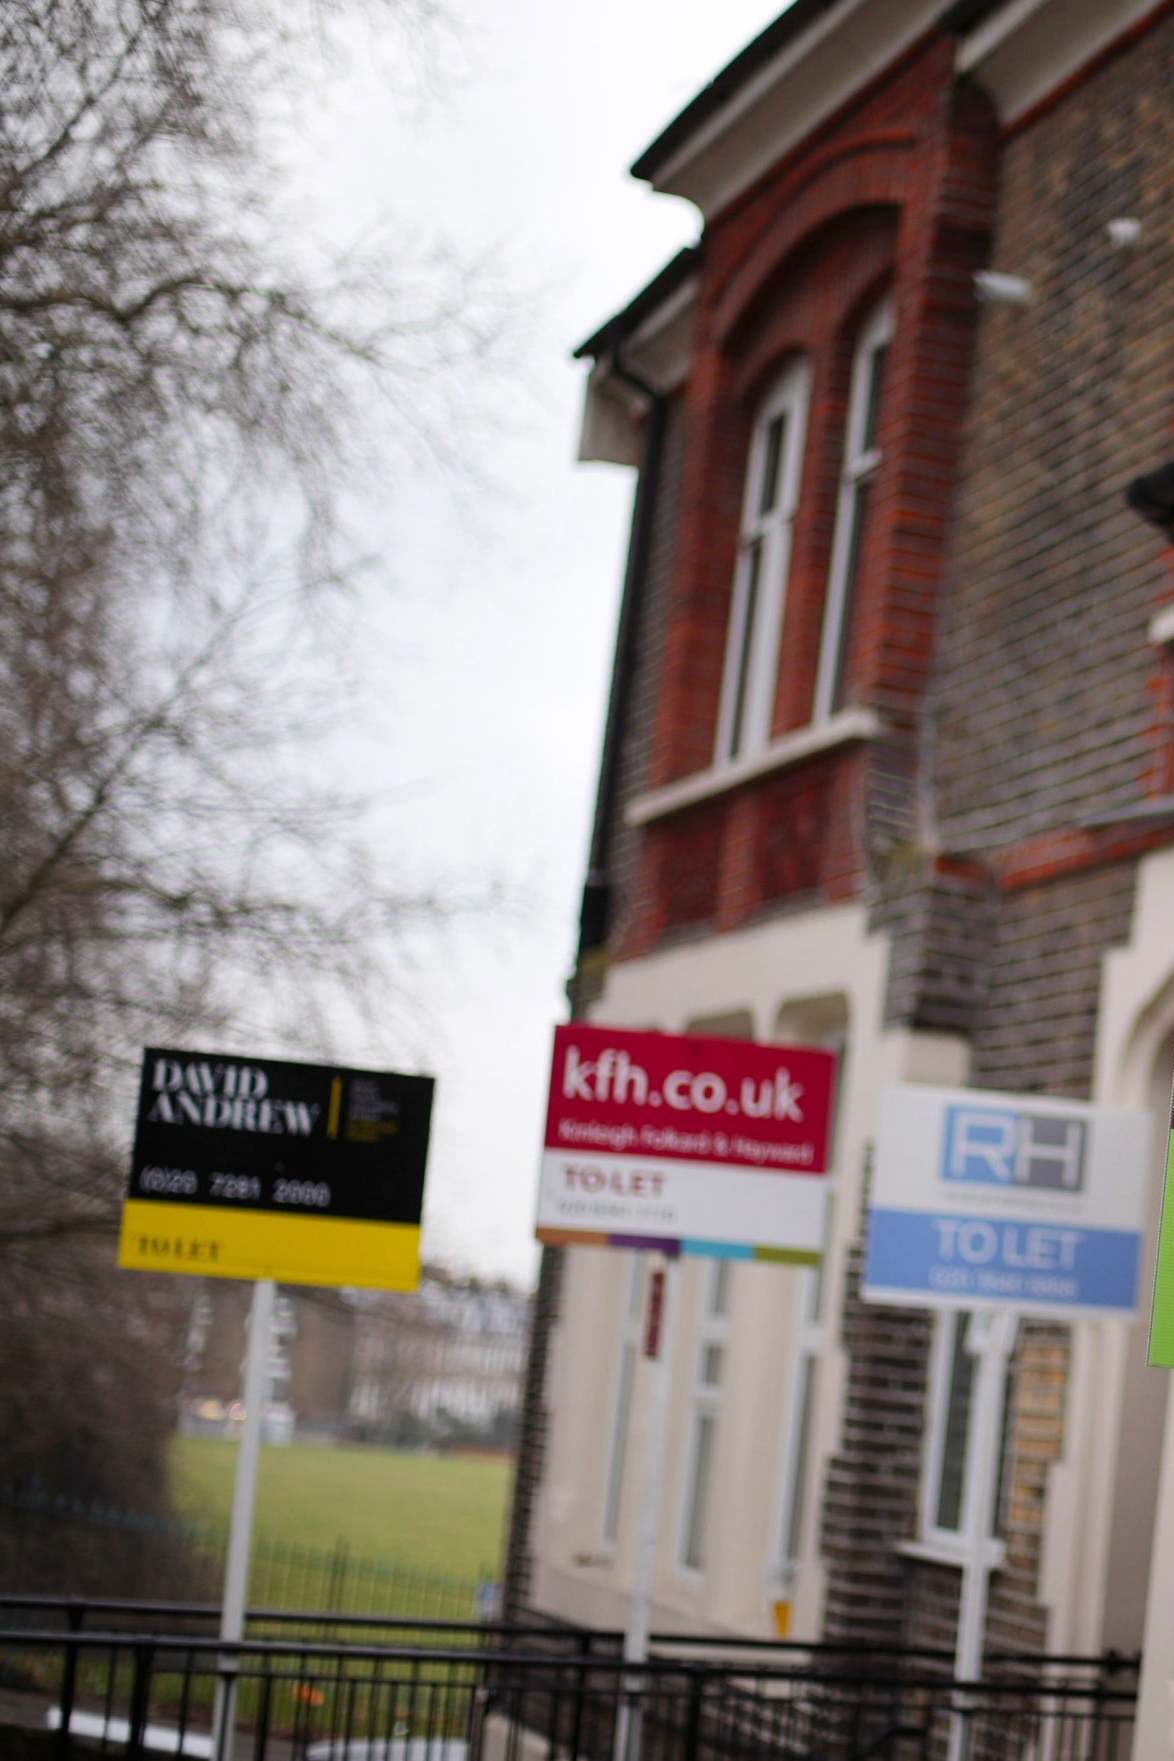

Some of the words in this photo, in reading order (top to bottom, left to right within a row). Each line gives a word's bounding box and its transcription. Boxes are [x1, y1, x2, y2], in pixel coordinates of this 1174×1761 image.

[152, 1058, 269, 1099] DAVID
[562, 1045, 804, 1123] kfh.co.uk
[148, 1089, 321, 1136] ANDREW
[948, 1107, 1084, 1189] RH
[562, 1164, 606, 1194] TO
[609, 1167, 666, 1197] LET
[931, 1218, 998, 1265] TO
[1002, 1226, 1088, 1271] LET
